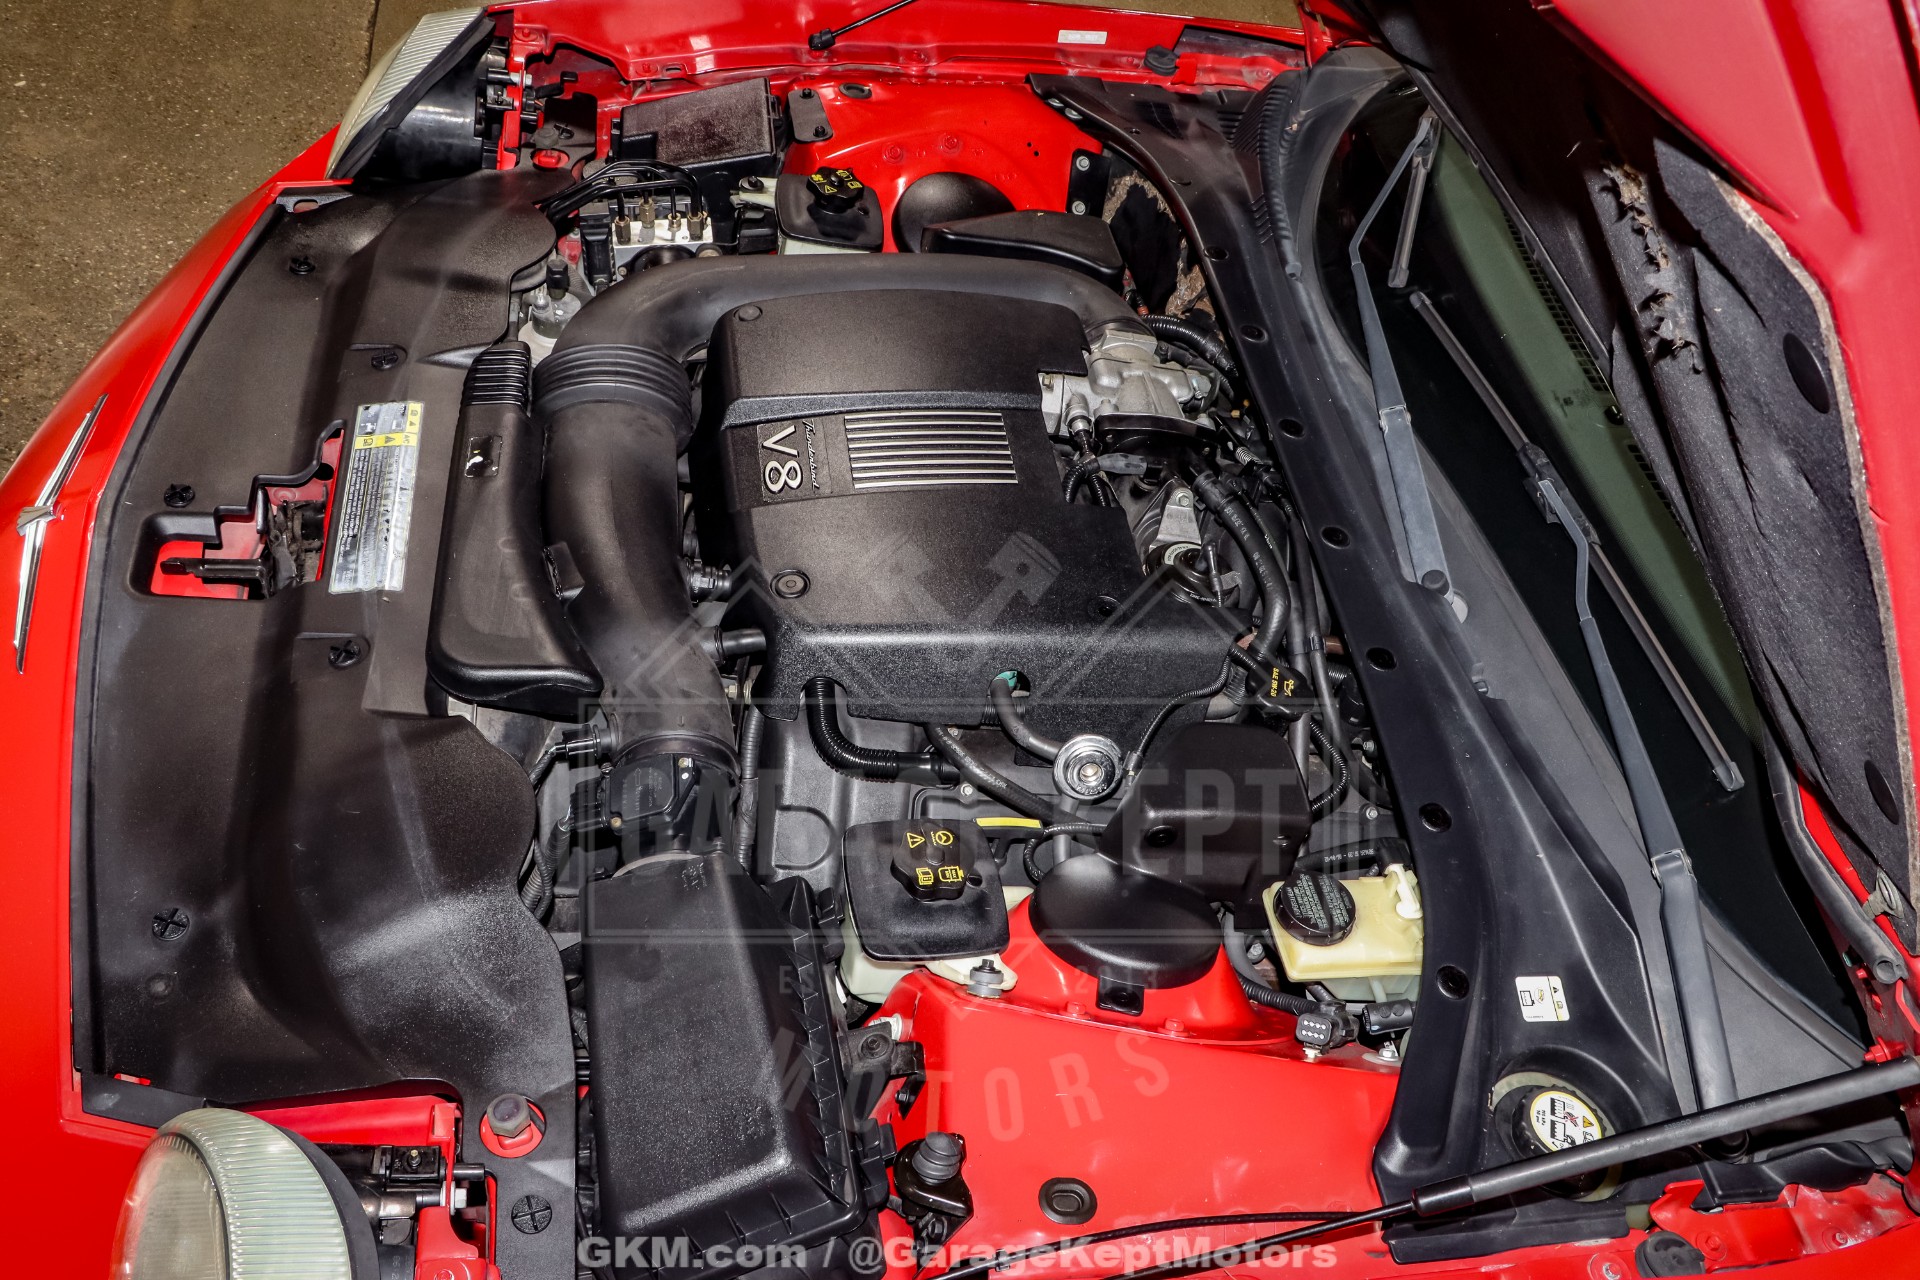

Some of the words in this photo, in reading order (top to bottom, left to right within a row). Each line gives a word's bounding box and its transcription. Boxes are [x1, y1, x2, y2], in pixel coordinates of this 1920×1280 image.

[762, 425, 802, 493] V8
[803, 419, 820, 490] Thunderbird
[1270, 680, 1278, 697] 5W-20
